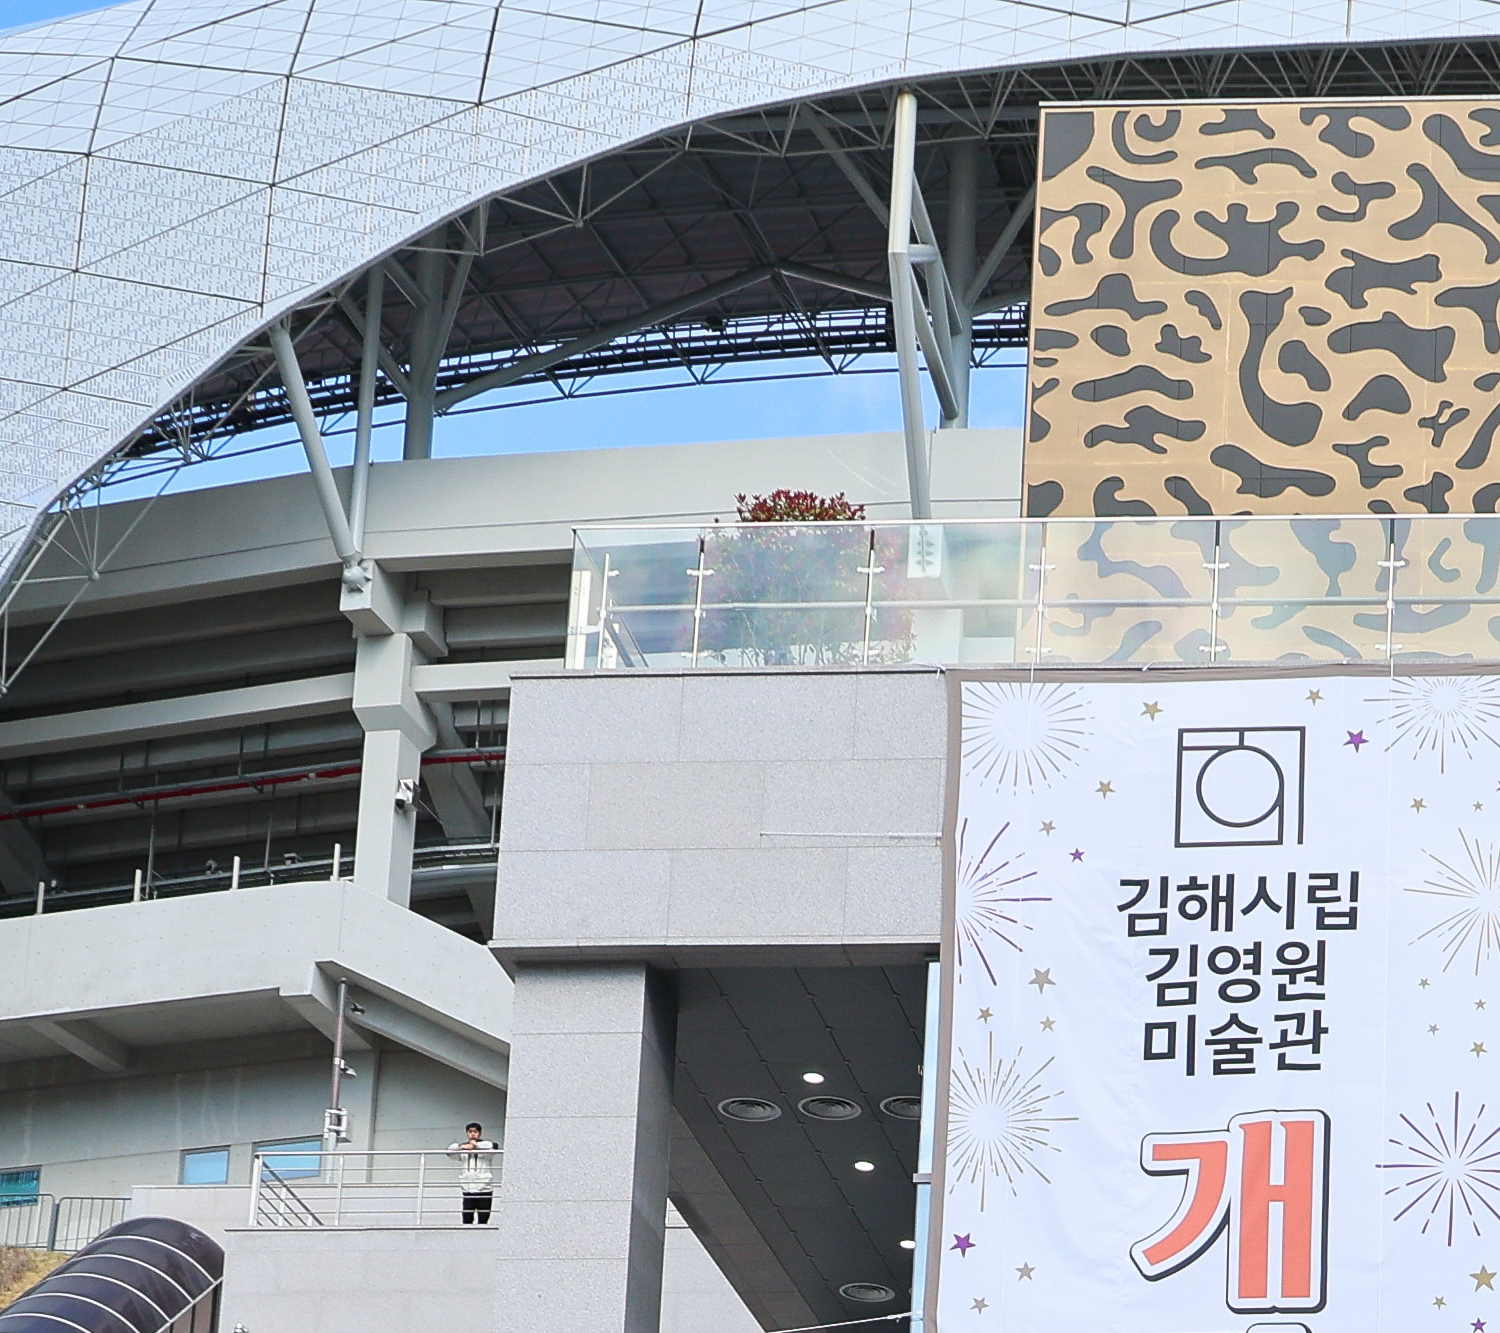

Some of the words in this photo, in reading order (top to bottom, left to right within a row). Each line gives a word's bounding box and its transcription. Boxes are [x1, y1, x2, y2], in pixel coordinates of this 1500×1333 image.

[1116, 871, 1360, 938] 김해시립
[1145, 939, 1326, 1007] 김영원
[1143, 1009, 1329, 1077] 미술관
